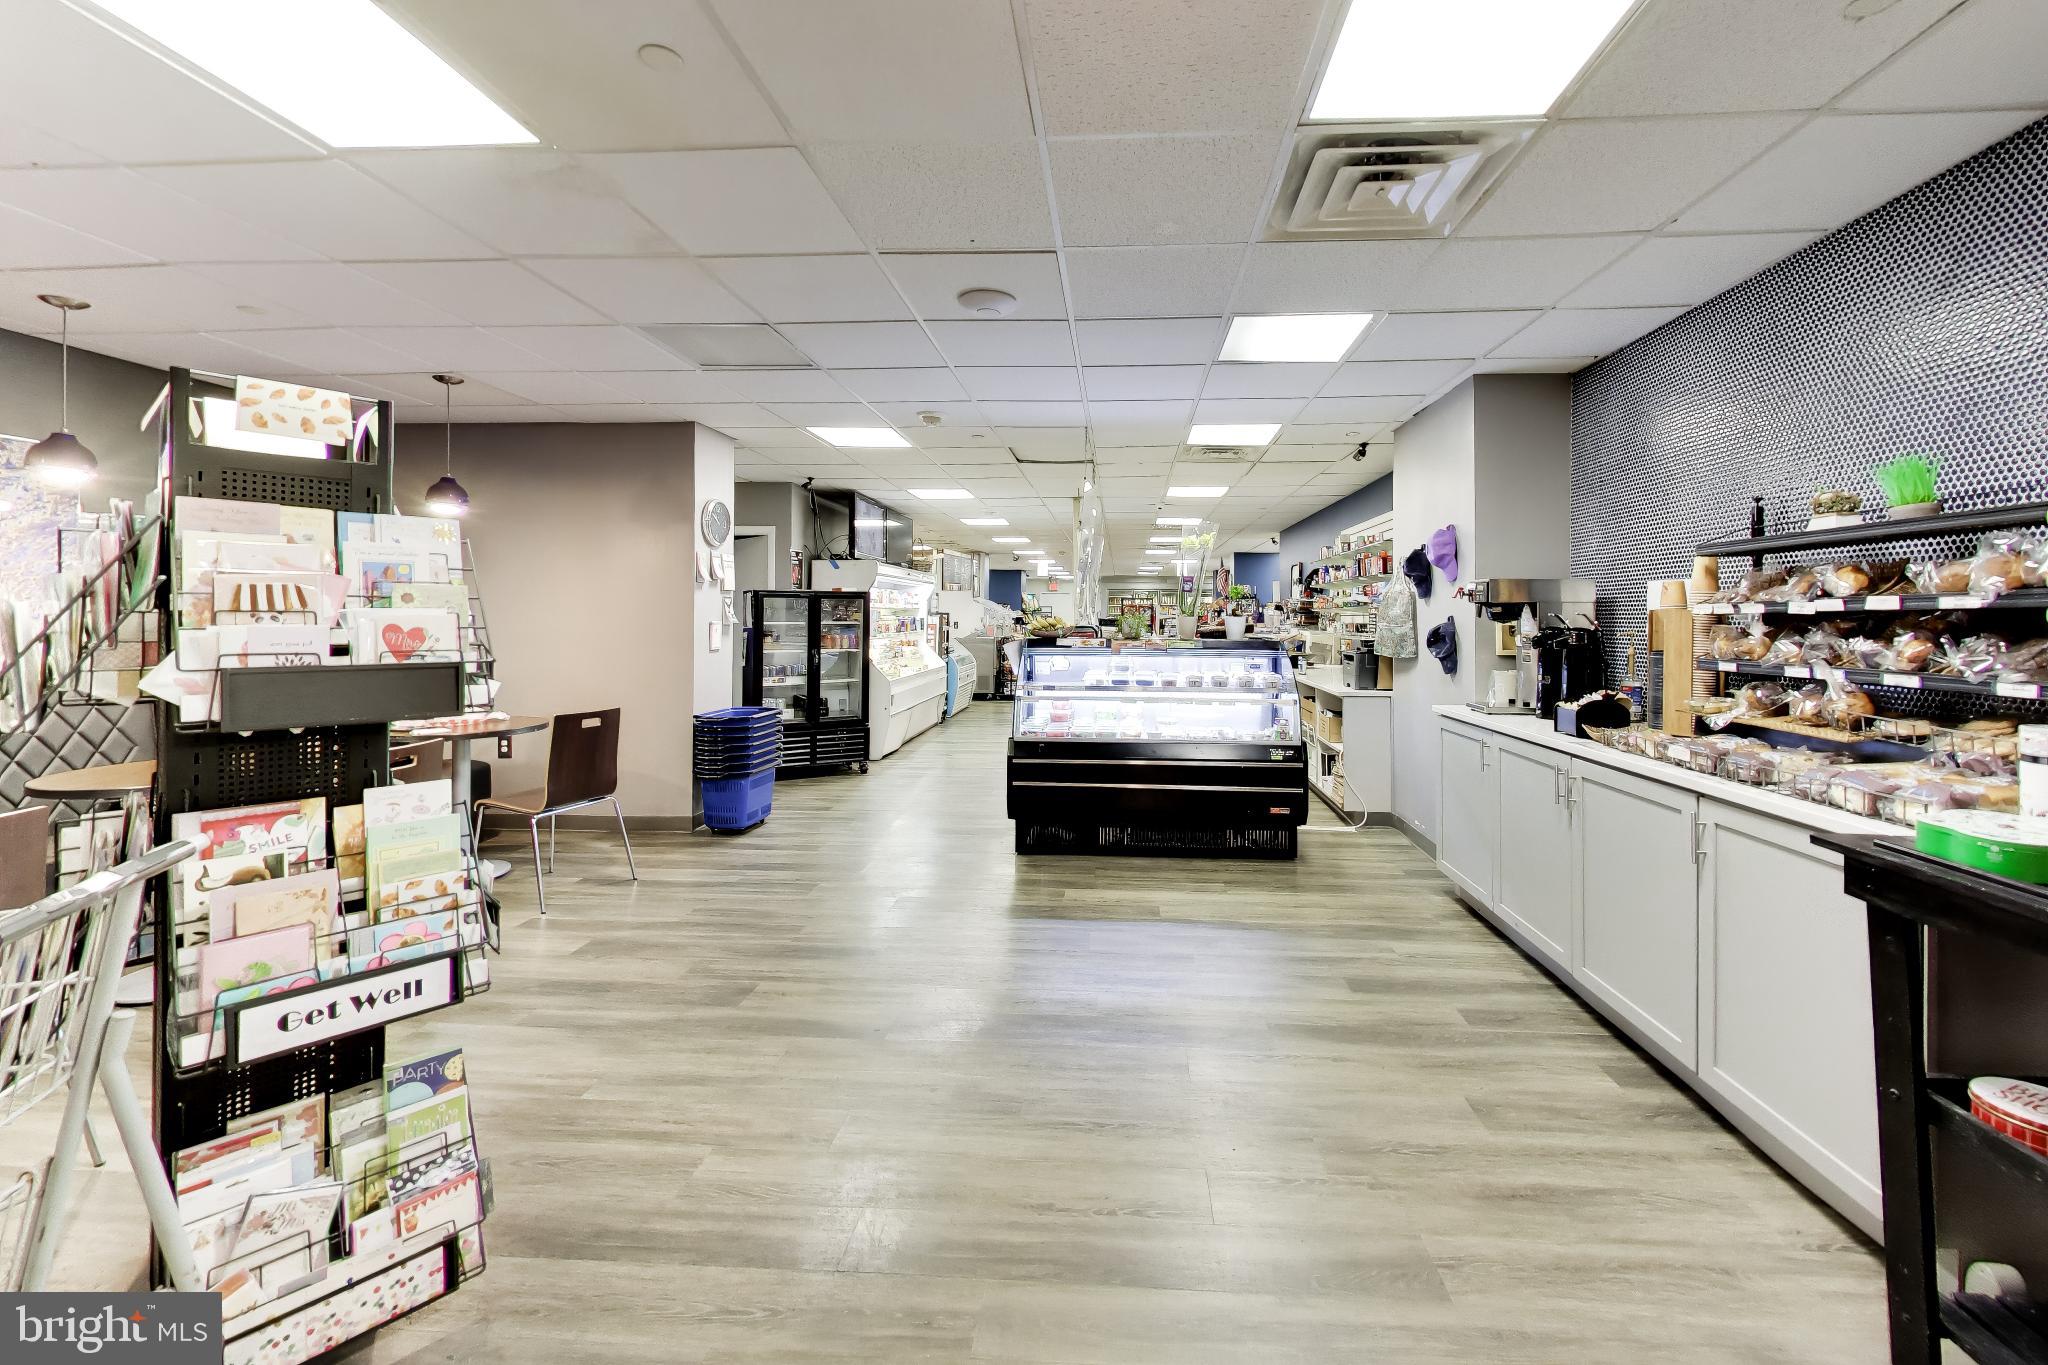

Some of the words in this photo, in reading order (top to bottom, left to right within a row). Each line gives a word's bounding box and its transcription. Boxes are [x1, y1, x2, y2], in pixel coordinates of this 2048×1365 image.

[248, 833, 294, 854] SMILE
[278, 996, 341, 1032] Get
[350, 979, 423, 1014] Well
[392, 1061, 444, 1087] PARTY
